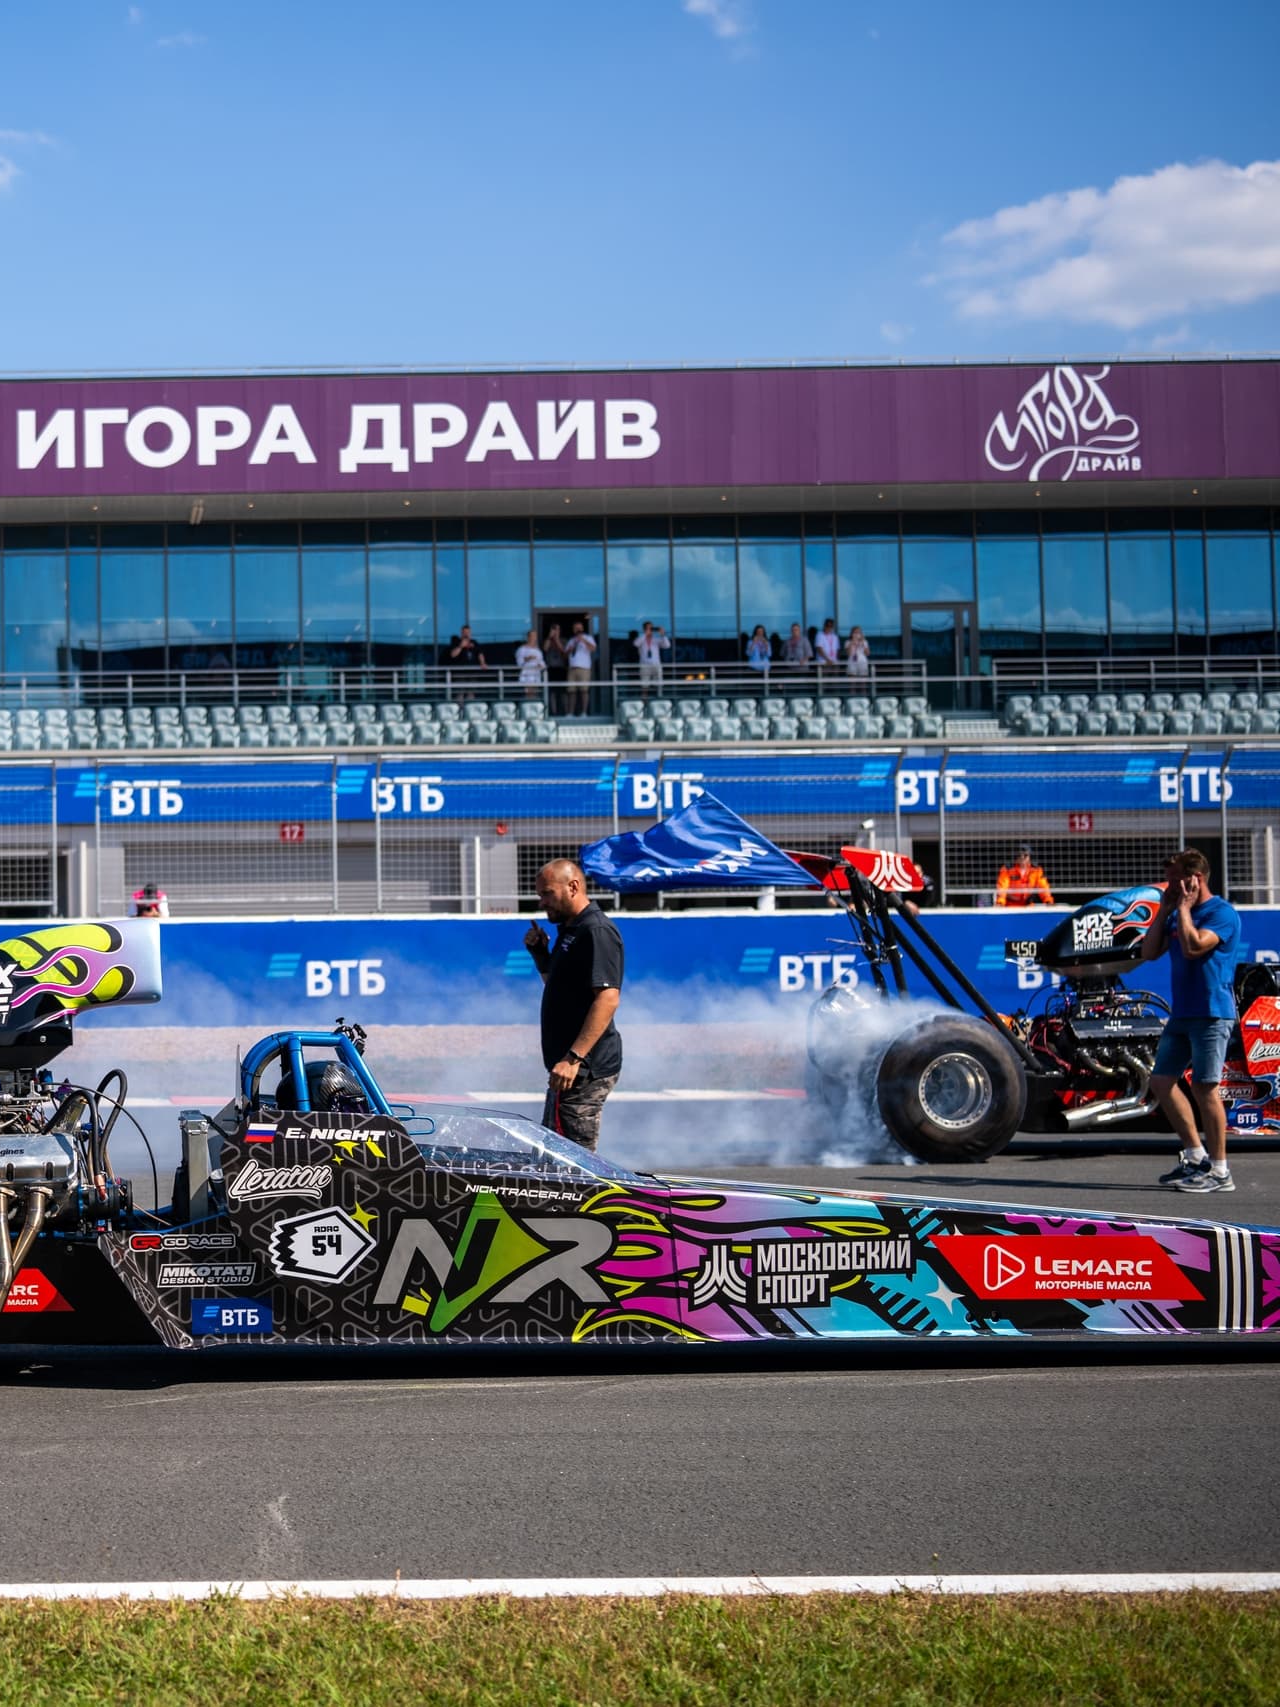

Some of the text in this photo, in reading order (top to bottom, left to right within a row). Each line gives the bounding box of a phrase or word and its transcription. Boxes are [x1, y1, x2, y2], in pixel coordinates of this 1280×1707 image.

[16, 399, 661, 473] ИГОРА ДРАЙВ
[1076, 453, 1142, 472] ДРАЙВ
[371, 776, 445, 812] ВТБ
[897, 769, 969, 806] ВТБ
[1159, 766, 1233, 802] ВТБ
[110, 779, 183, 816] ВТБ
[284, 825, 301, 840] 17
[1072, 815, 1090, 830] 15
[1072, 911, 1113, 931] MAX
[306, 960, 386, 997] ВТБ
[779, 954, 859, 992] ВТБ
[1237, 1113, 1258, 1124] ВТБ
[285, 1127, 386, 1141] E. NIGHT
[312, 1234, 342, 1256] 54
[757, 1234, 911, 1272] МОСКОВСКИЙ
[163, 1265, 252, 1277] MIKOTATI
[1035, 1256, 1153, 1276] LEMARC
[161, 1276, 250, 1285] DESIGN STUDIO
[757, 1273, 829, 1305] СПОРТ
[1035, 1281, 1152, 1290] МОТОРНЫЕ МАСЛА
[221, 1308, 260, 1327] ВТБ
